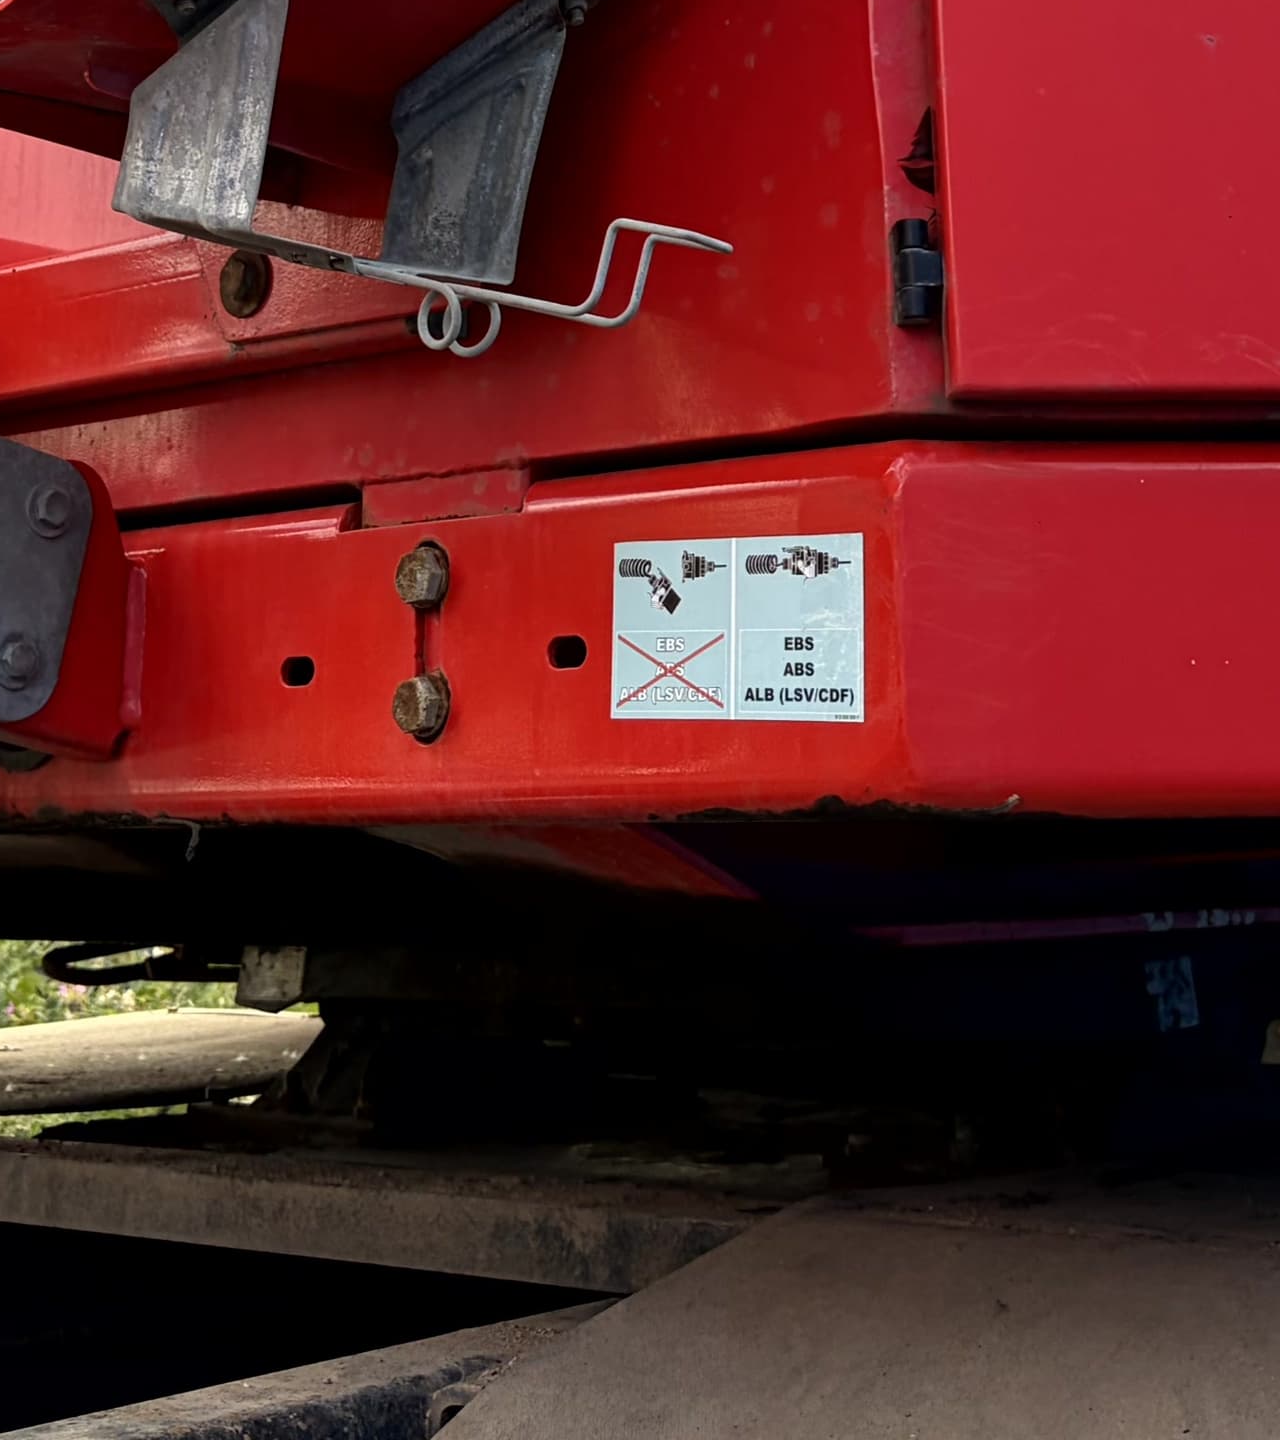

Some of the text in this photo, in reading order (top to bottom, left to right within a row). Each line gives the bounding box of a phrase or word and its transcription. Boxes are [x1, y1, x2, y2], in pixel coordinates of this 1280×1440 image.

[655, 637, 686, 652] EBS
[783, 636, 815, 651] EBS
[783, 662, 815, 677] ABS
[620, 686, 648, 702] ALB
[744, 687, 855, 707] ALB (LSV/CDF)
